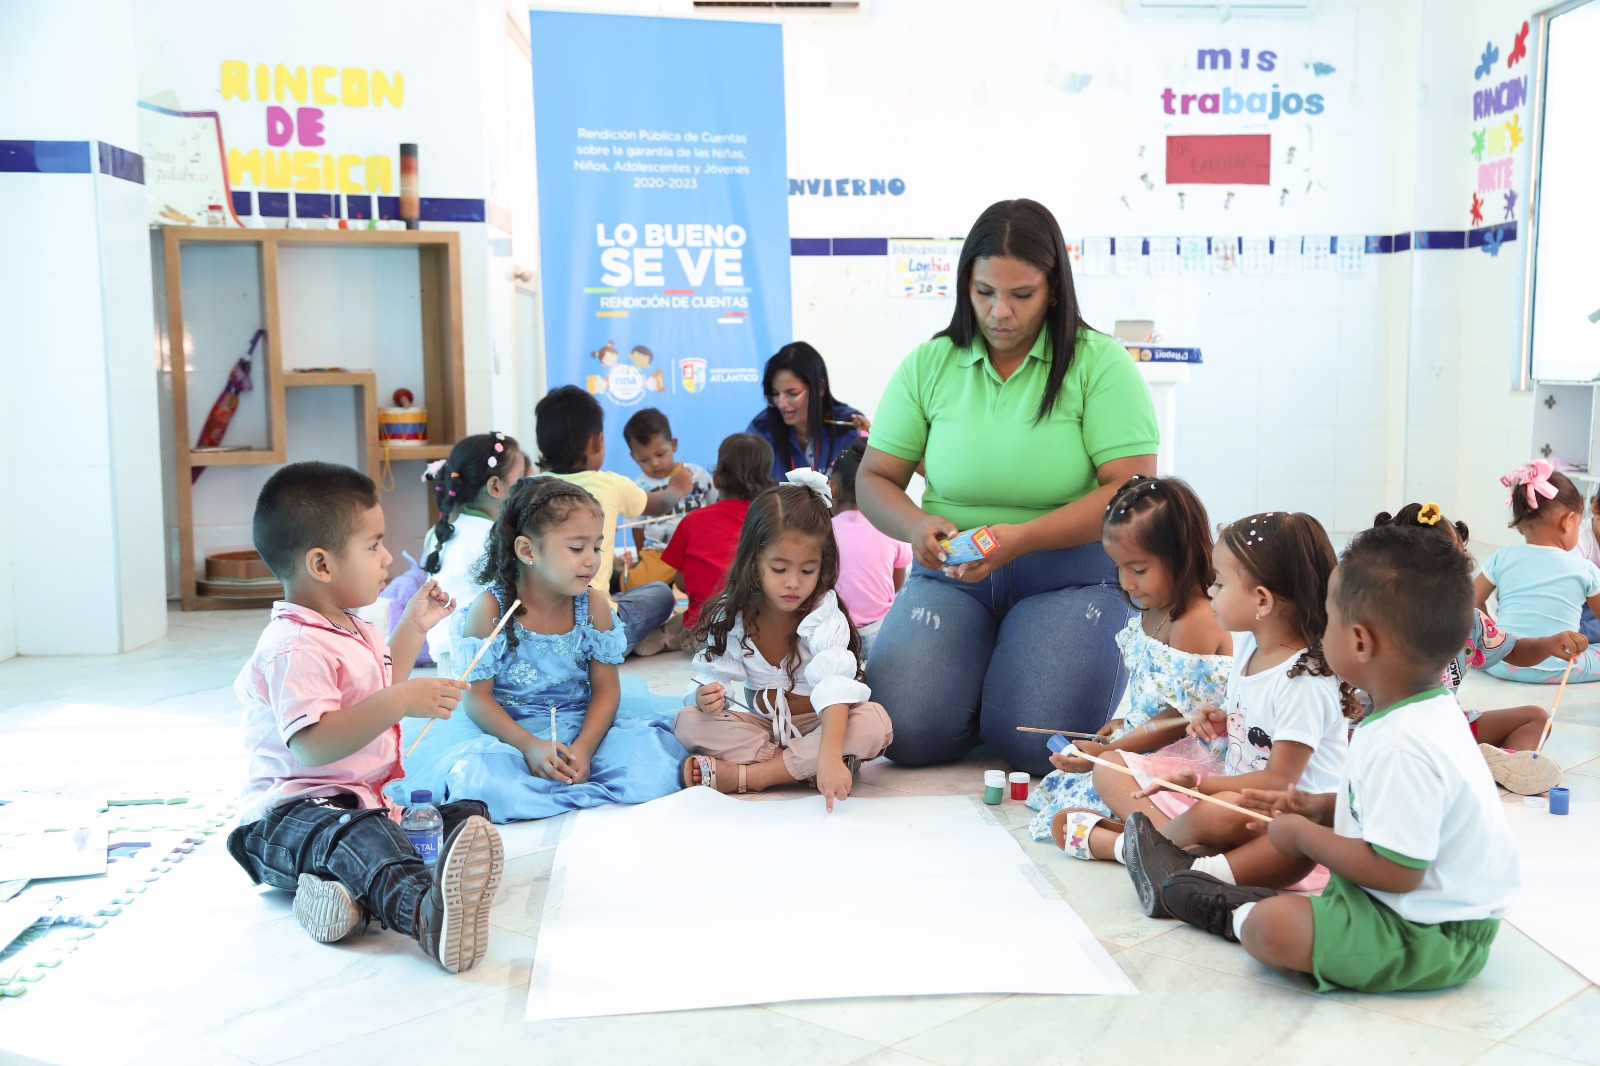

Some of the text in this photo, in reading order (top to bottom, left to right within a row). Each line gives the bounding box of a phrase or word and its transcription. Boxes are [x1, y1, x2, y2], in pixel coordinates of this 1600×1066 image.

[1197, 48, 1278, 72] mis
[220, 59, 405, 109] RINCON
[1160, 83, 1325, 120] trabajos
[1473, 74, 1528, 122] RINCON
[266, 106, 326, 147] DE
[577, 127, 748, 144] Rendición Pública de Cuentas
[576, 144, 610, 157] sobre
[612, 145, 624, 157] la
[676, 146, 692, 159] de
[693, 147, 710, 159] las
[1487, 124, 1506, 156] DE
[227, 147, 393, 196] MUSICA
[573, 160, 750, 176] Niños, Adolescentes y Jóvenes
[1478, 157, 1513, 194] ARTE
[633, 177, 698, 190] 2020-2023
[788, 178, 906, 197] NVIERNO
[596, 222, 748, 248] LO BUENO
[600, 247, 744, 287] SE VE
[600, 294, 749, 309] RENDICIÓN DE CUENTAS
[414, 843, 436, 852] STAL
